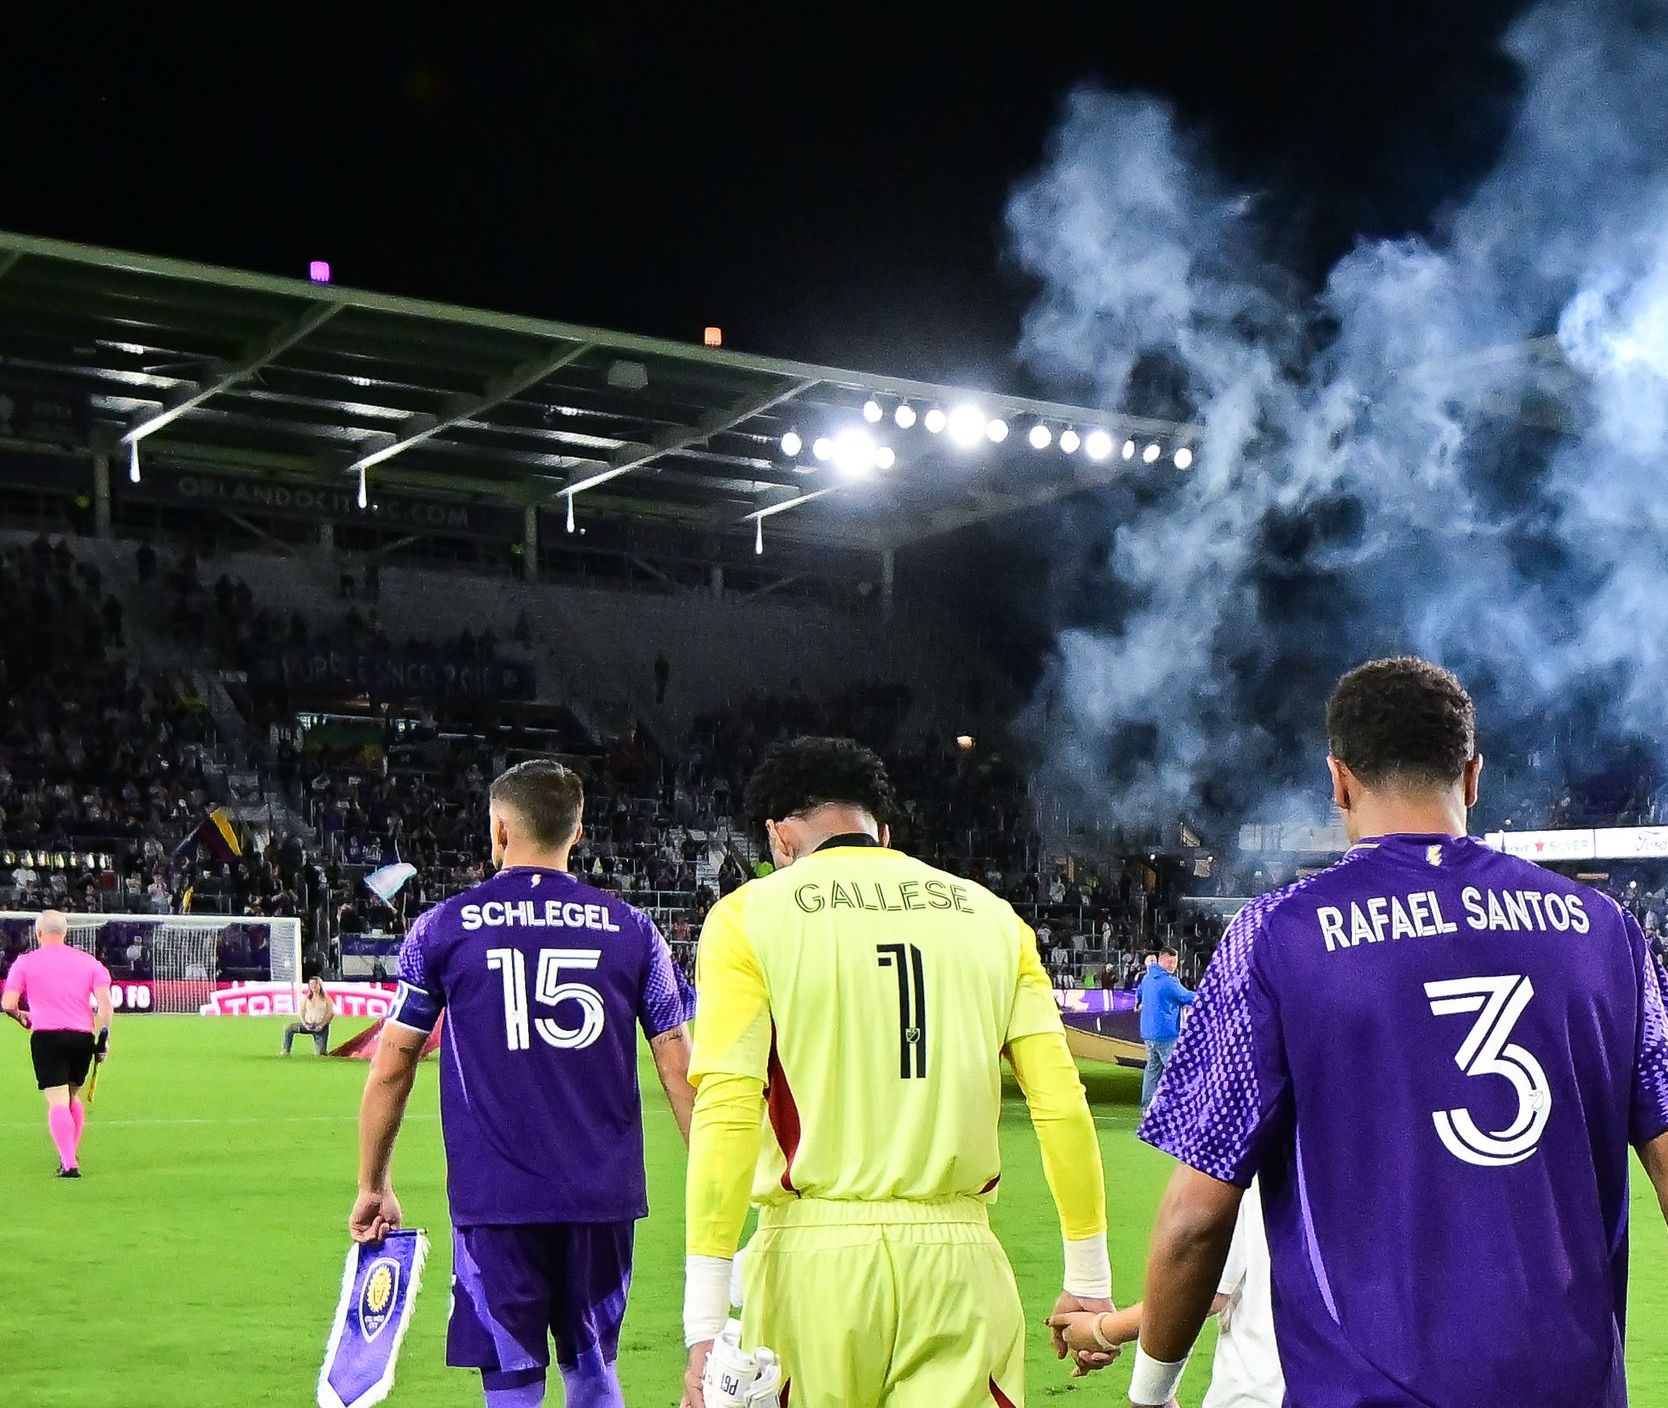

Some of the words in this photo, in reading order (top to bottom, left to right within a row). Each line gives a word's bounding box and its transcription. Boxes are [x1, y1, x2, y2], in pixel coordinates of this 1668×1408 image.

[461, 900, 620, 932] SCHLEGEL
[795, 880, 974, 914] GALLESE
[1315, 892, 1457, 952] RAFAEL
[1464, 885, 1591, 935] SANTOS
[226, 995, 389, 1017] TORNTO
[487, 948, 606, 1051] 15
[876, 942, 927, 1079] 1
[1423, 974, 1552, 1167] 3
